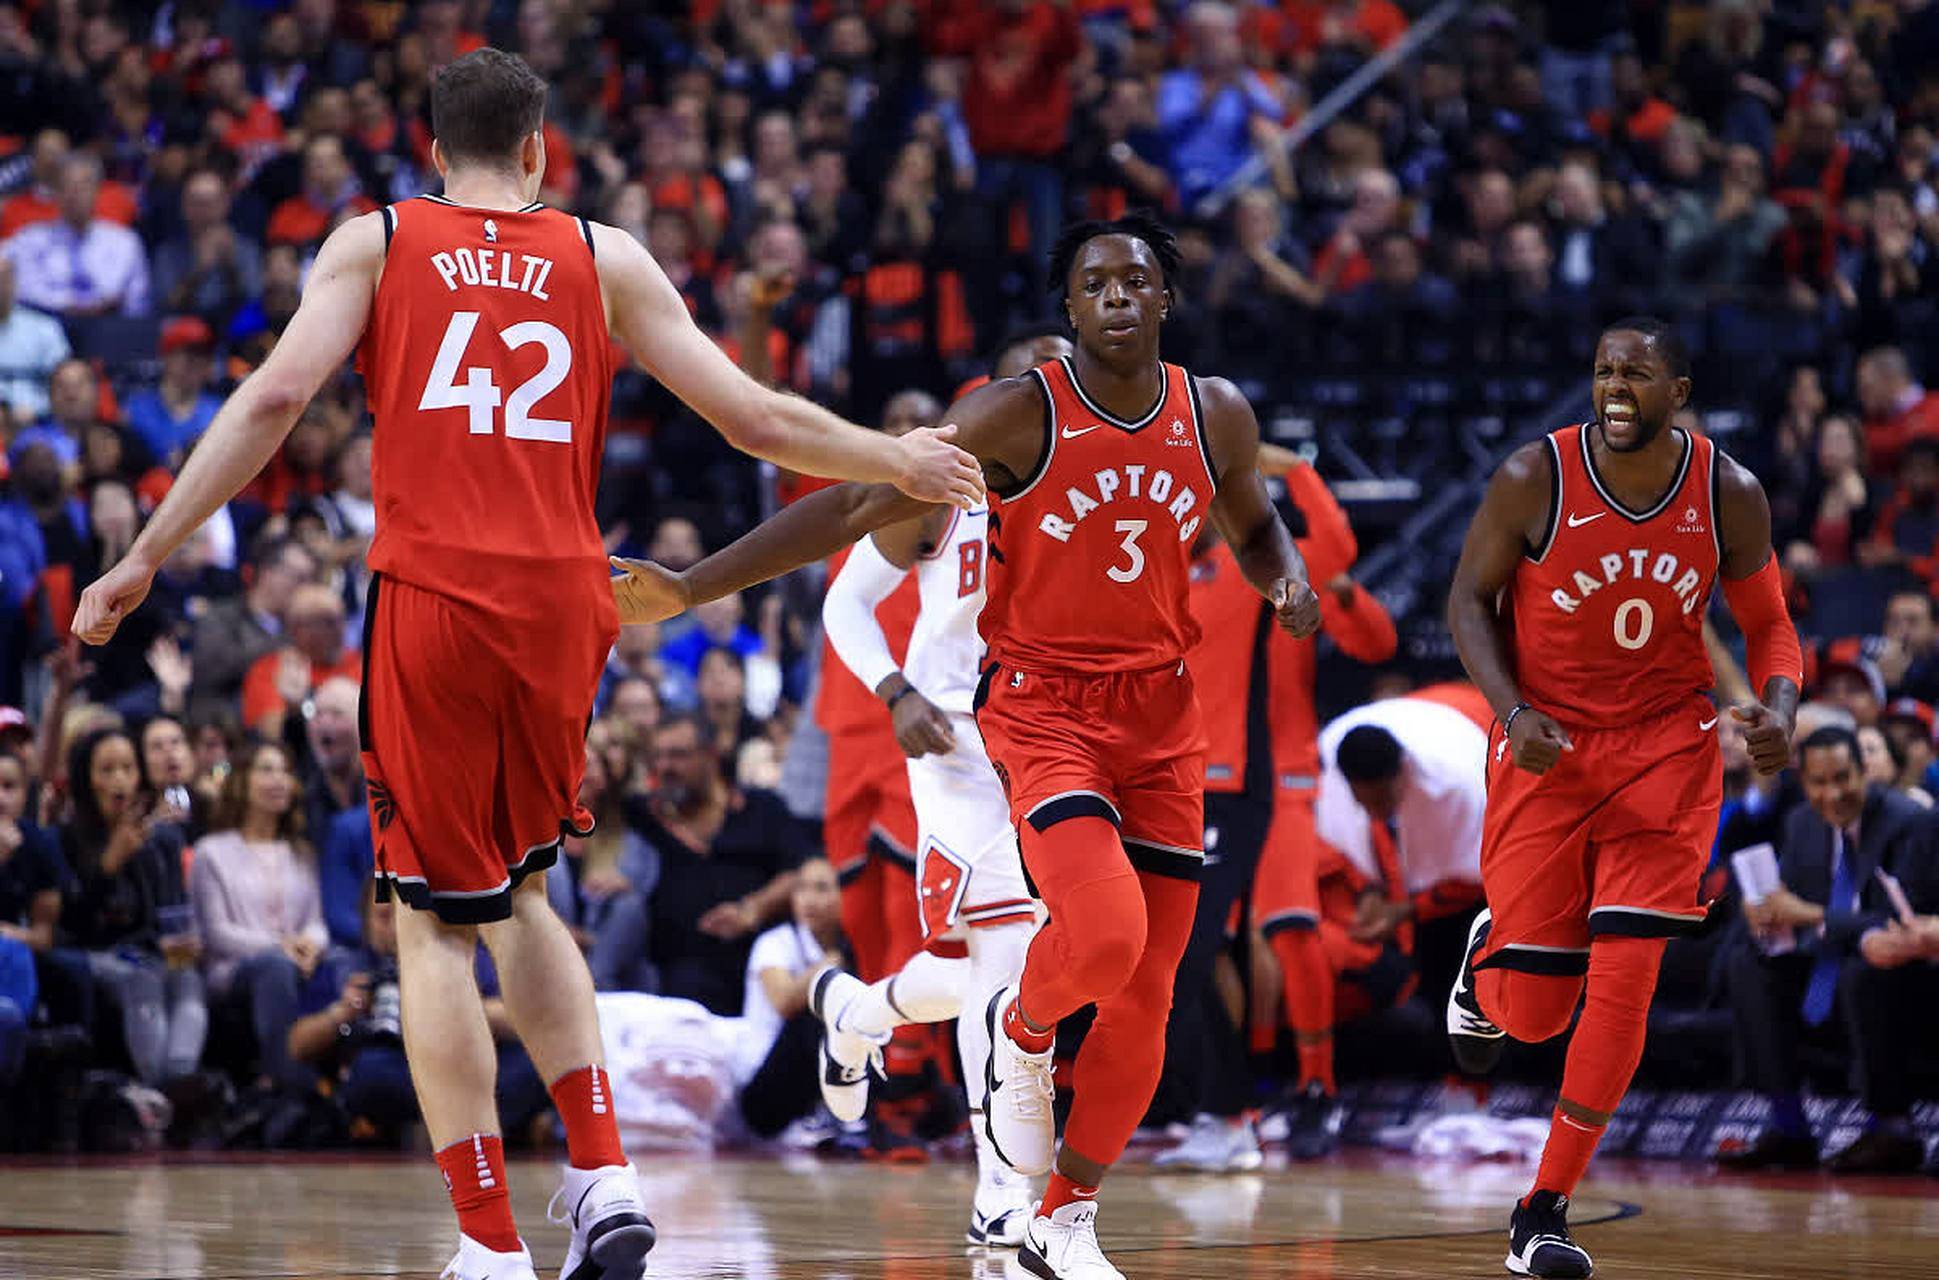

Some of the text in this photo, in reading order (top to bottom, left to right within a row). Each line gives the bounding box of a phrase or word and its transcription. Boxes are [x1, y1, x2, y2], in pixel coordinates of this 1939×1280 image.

[431, 248, 552, 301] POELTL
[418, 311, 572, 443] 42
[1039, 465, 1200, 543] RAPTORS
[1106, 519, 1148, 583] 3
[1613, 598, 1653, 650] 0
